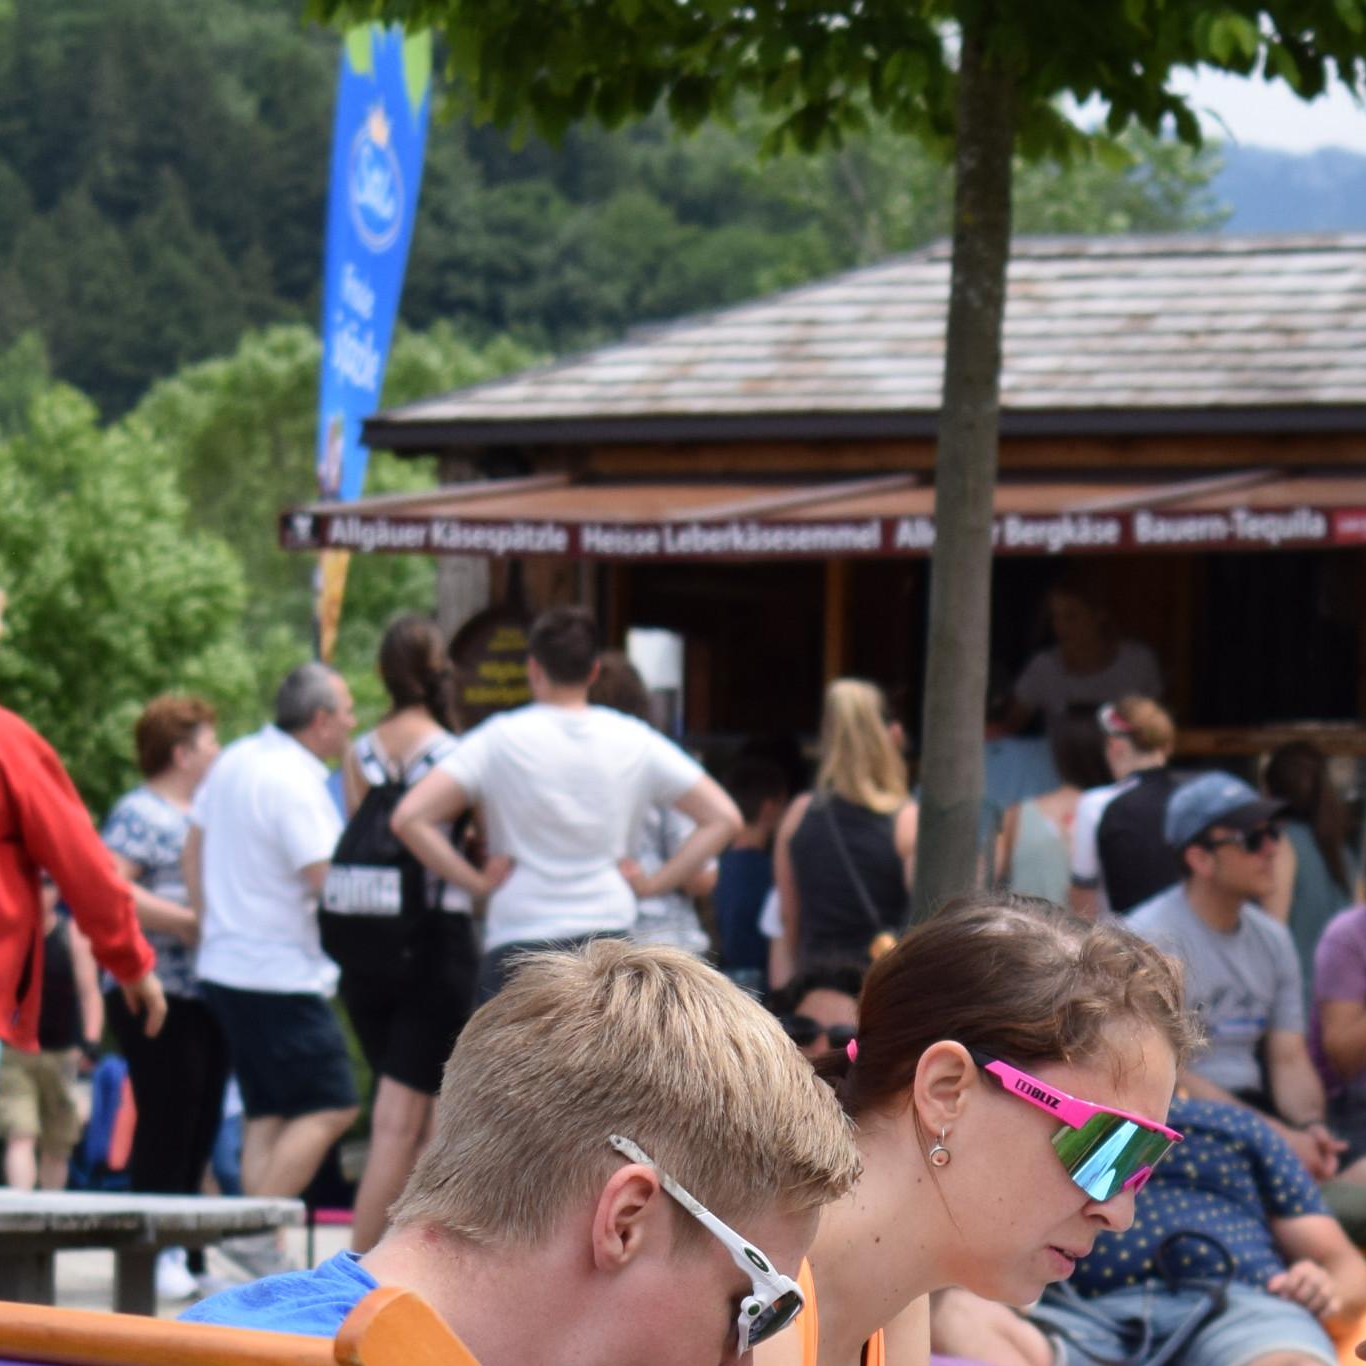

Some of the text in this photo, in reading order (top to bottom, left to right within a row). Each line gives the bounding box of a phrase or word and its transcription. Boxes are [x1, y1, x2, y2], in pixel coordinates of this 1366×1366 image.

[329, 518, 427, 551] Allgäuer
[431, 518, 569, 554] Käsespätzle
[582, 523, 658, 554] Heisse
[664, 520, 881, 553] Leberkäsesemmel
[1005, 514, 1120, 551] Bergkäse
[1135, 506, 1326, 544] Bauern-Tequila
[1031, 1087, 1061, 1109] BLIZ
